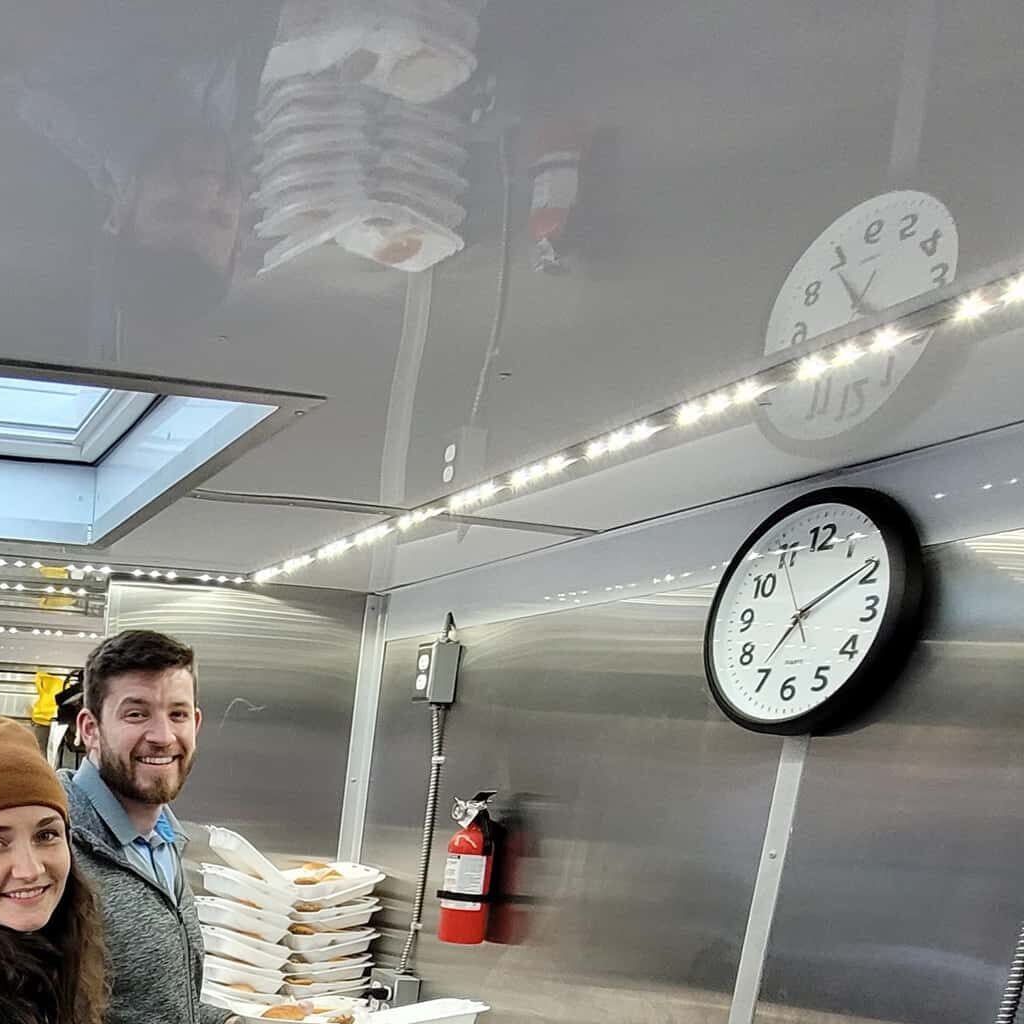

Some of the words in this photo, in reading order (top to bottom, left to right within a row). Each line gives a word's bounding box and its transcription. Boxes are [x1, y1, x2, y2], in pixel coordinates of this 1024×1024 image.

[809, 523, 837, 552] 12
[778, 542, 800, 569] 11
[859, 558, 880, 585] 2
[753, 573, 776, 599] 10
[740, 608, 754, 633] 9
[860, 595, 880, 623] 3
[739, 642, 755, 666] 8
[839, 634, 859, 660] 4
[755, 668, 772, 693] 7
[780, 676, 796, 701] 6
[811, 666, 831, 691] 5
